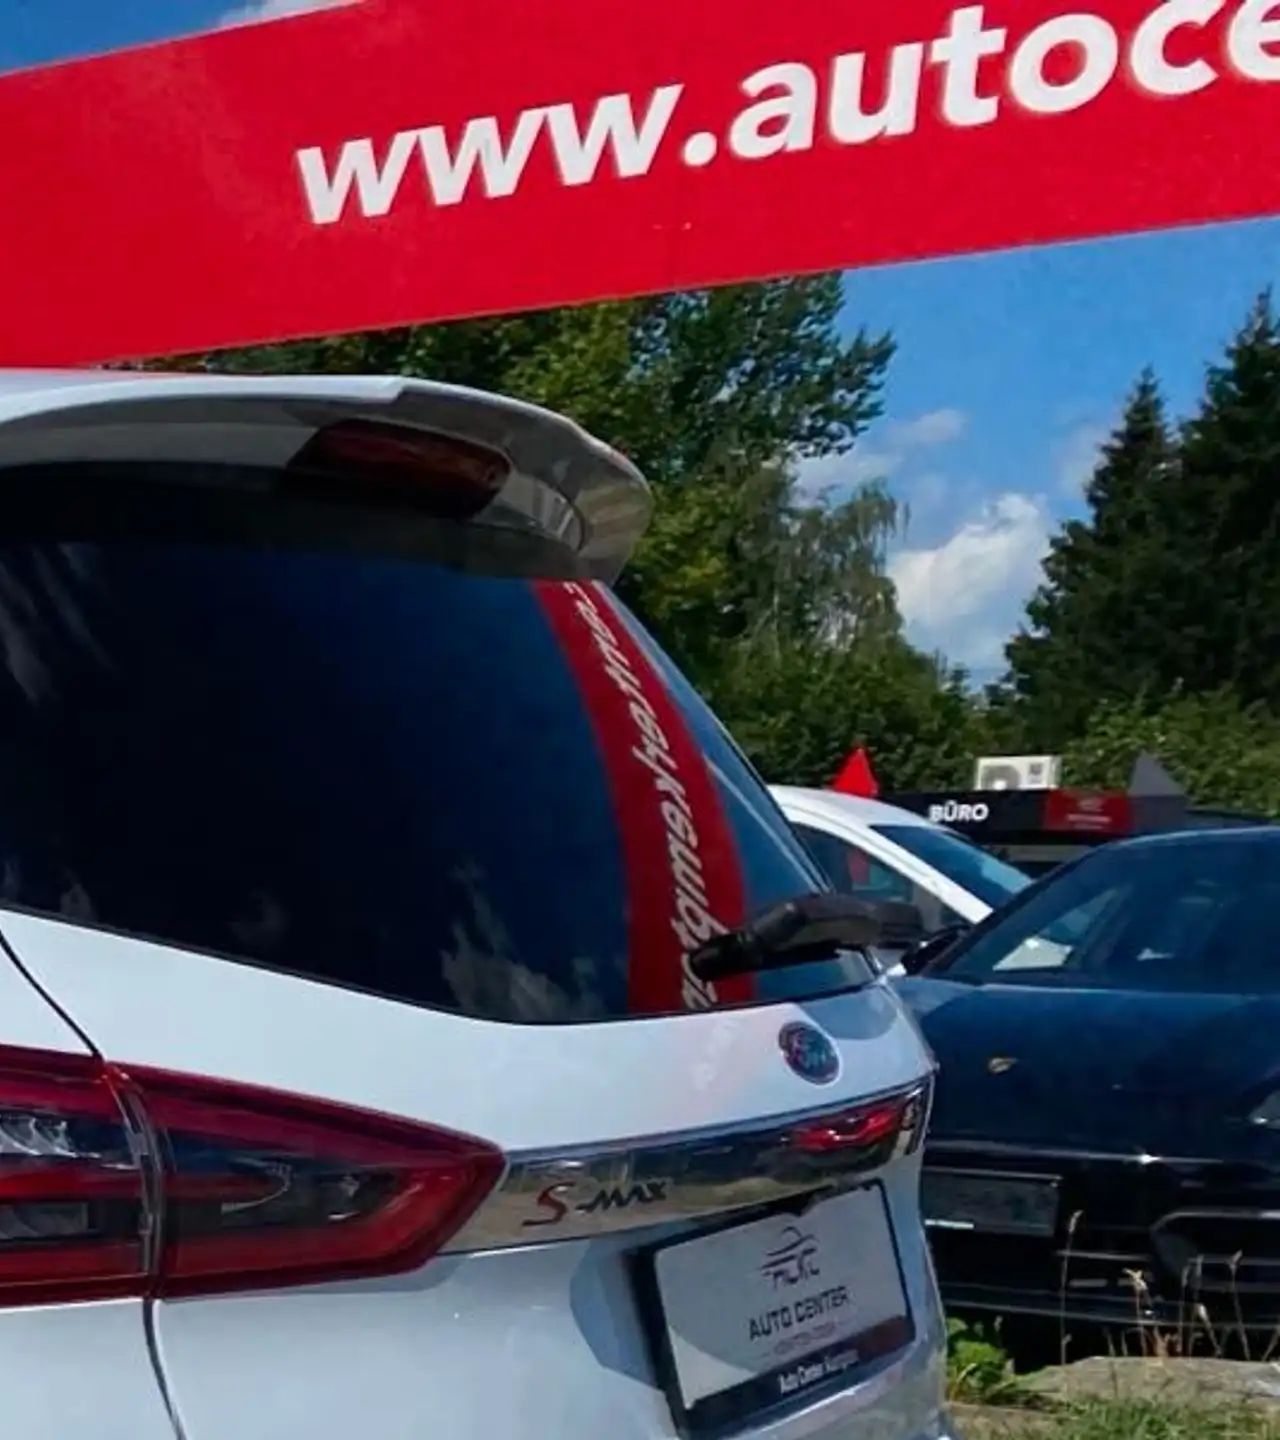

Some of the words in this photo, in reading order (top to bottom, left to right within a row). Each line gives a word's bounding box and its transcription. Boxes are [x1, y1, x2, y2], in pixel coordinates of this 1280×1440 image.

[296, 0, 1280, 225] www.autoce
[928, 800, 989, 822] BÜRO
[747, 1304, 793, 1341] AUTO
[793, 1284, 851, 1324] CENTER
